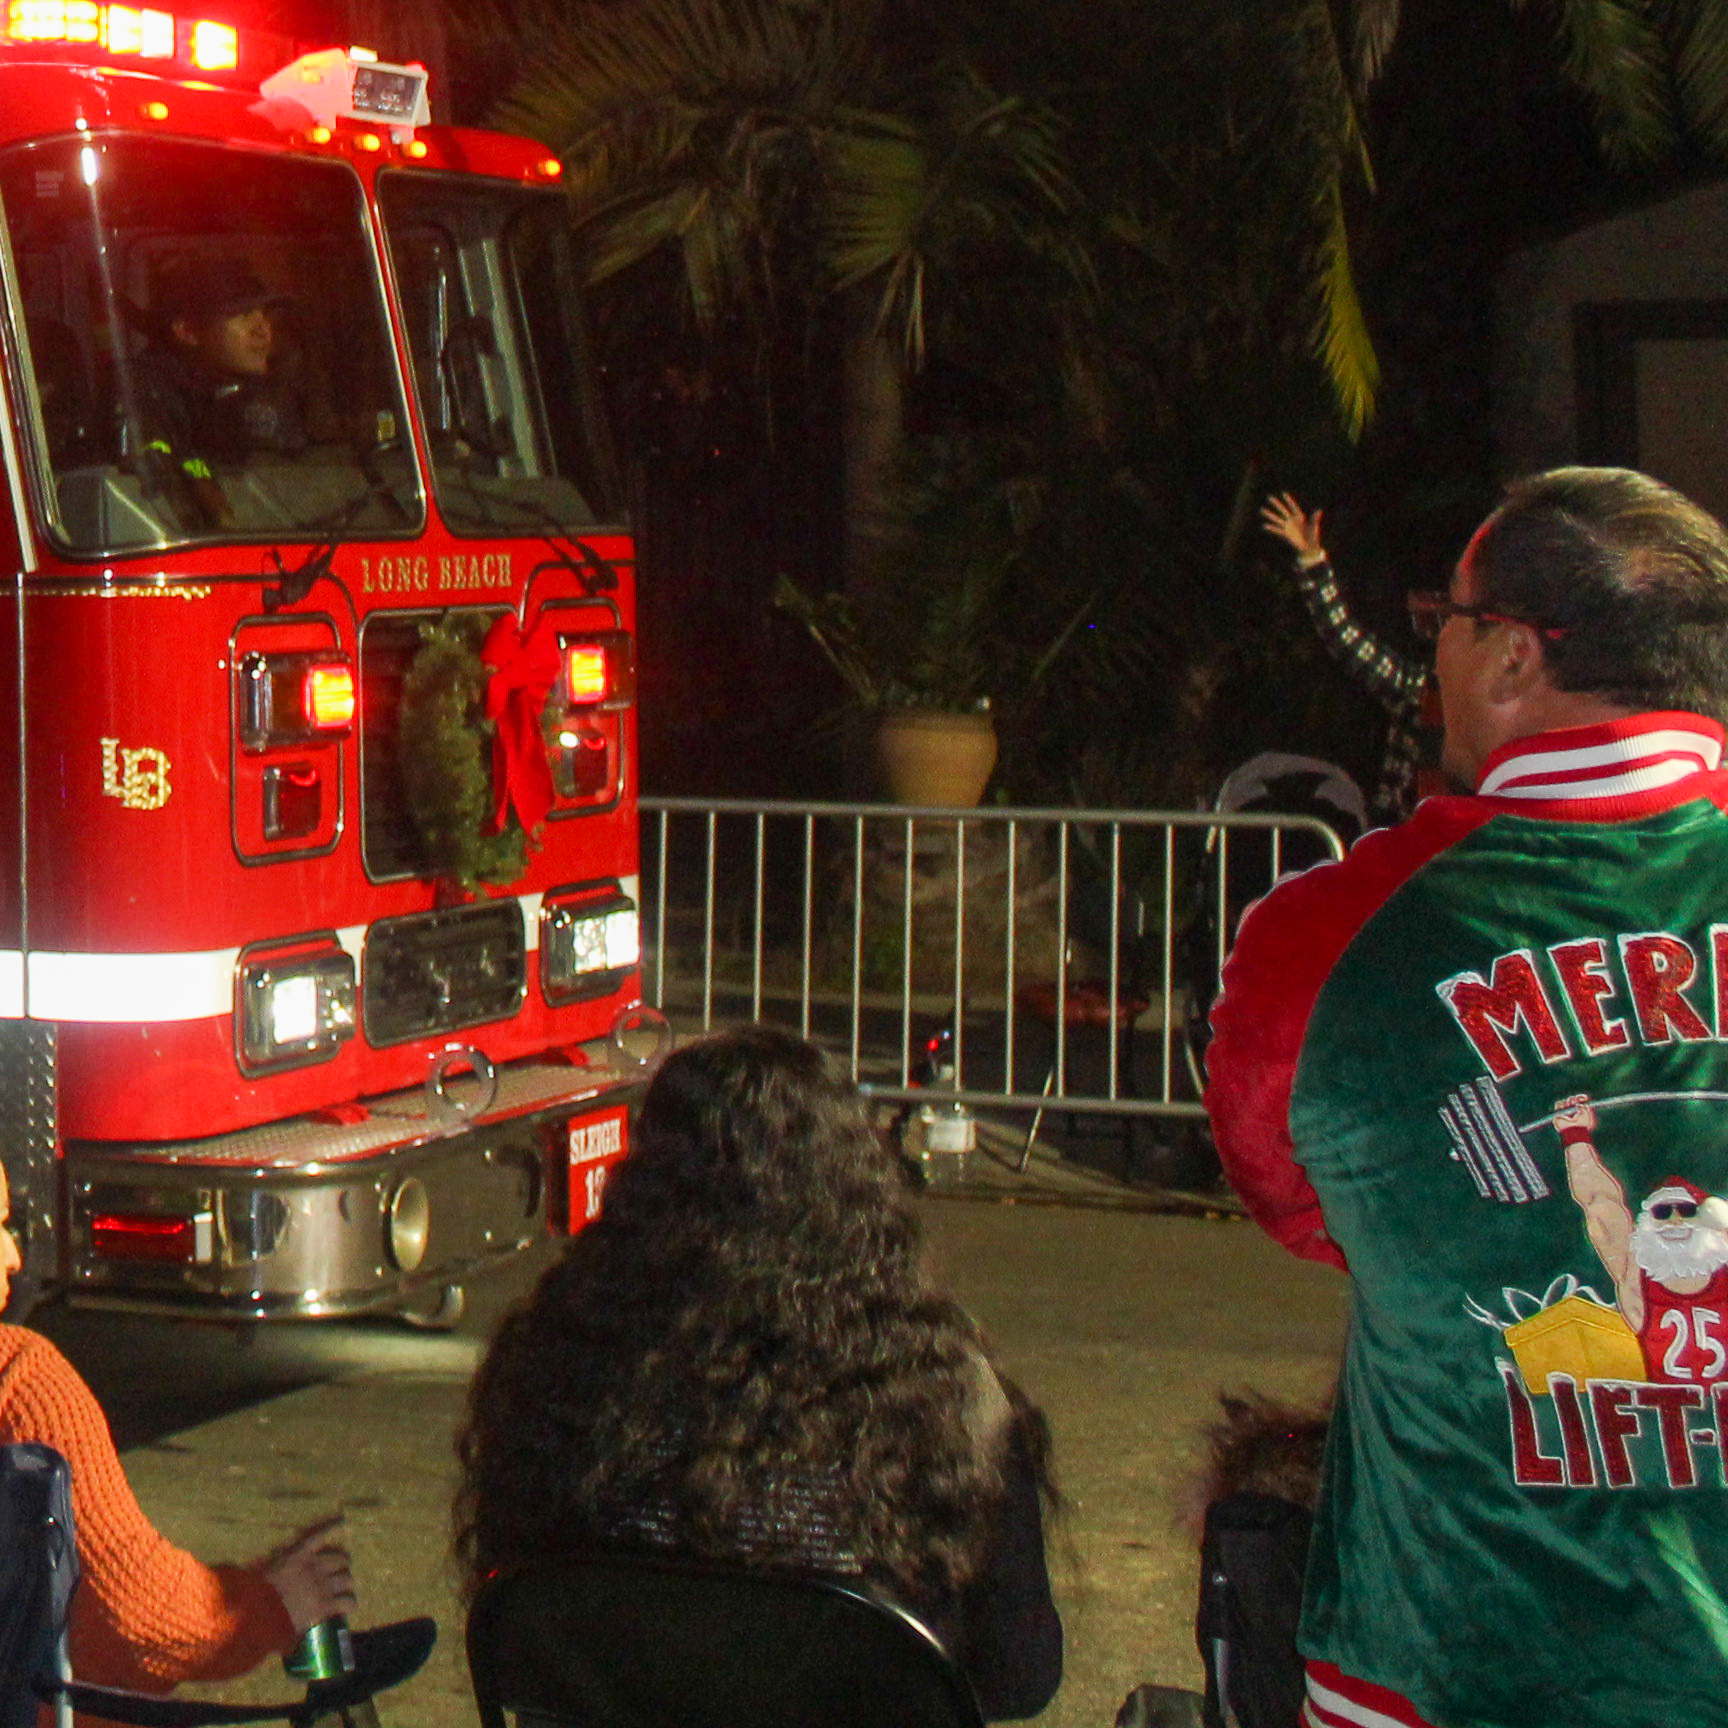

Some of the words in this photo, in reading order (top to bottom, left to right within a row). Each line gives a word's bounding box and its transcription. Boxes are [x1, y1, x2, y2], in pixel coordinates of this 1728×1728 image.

[361, 556, 429, 593] LONG
[439, 553, 513, 590] BEACH
[1435, 923, 1728, 1083] MER
[570, 1118, 622, 1165] SLEIGH
[1660, 1307, 1726, 1379] 25
[1494, 1355, 1728, 1489] LIFT-
